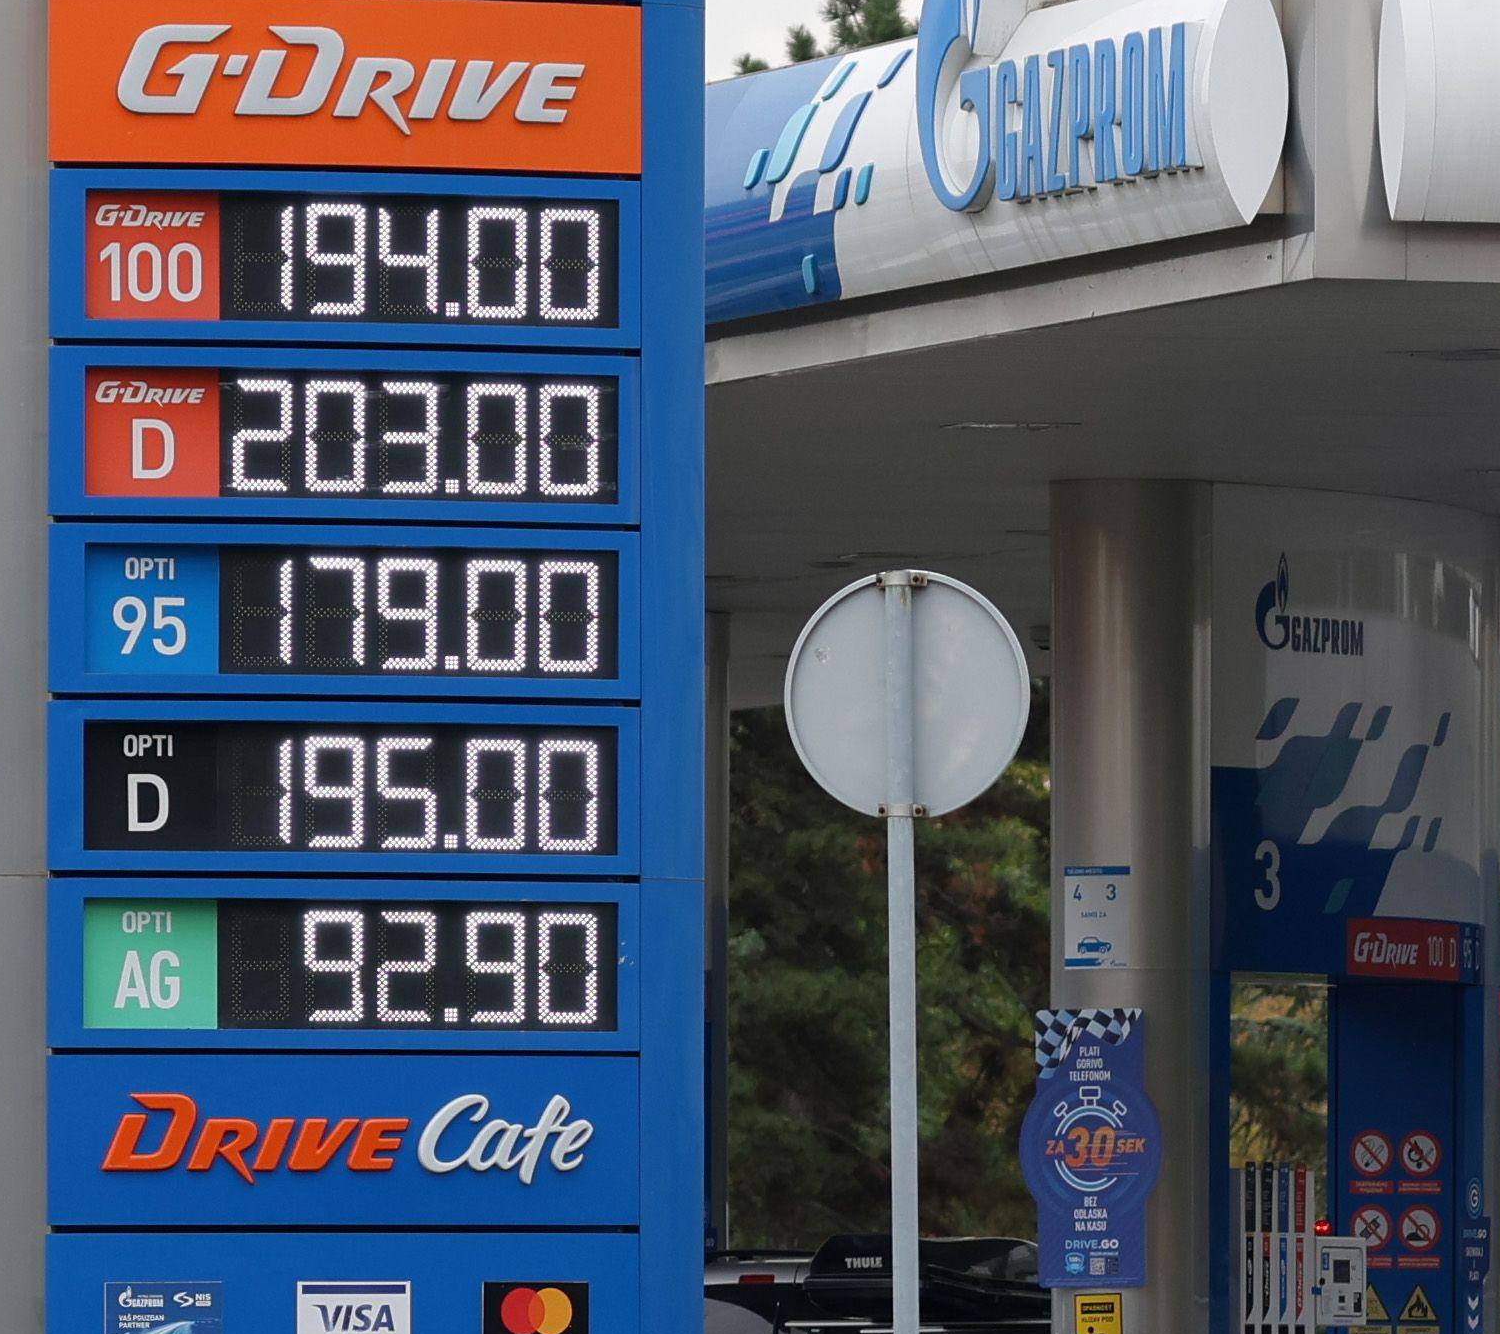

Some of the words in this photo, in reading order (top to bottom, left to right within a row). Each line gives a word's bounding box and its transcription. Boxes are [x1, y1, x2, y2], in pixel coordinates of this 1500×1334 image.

[997, 22, 1186, 201] GAZPROM
[99, 241, 202, 302] 100
[279, 203, 600, 321] 194.00
[132, 419, 176, 479] D
[231, 379, 600, 495] 203.00
[124, 557, 175, 580] OPTI
[112, 597, 187, 656] 95
[278, 557, 600, 672] 179.00
[1290, 615, 1363, 657] GAZPROM
[122, 734, 174, 757] OPTI
[127, 774, 169, 832] D
[277, 737, 599, 850] 195.00
[1254, 839, 1280, 910] 3
[1073, 884, 1082, 901] 4
[1106, 884, 1116, 901] 3
[121, 911, 173, 933] OPTI
[304, 909, 599, 1023] 92.90
[1427, 936, 1444, 967] 100
[114, 950, 181, 1009] AG
[1076, 1058, 1103, 1069] GORIVO
[1079, 1046, 1100, 1056] PLATI
[1069, 1071, 1111, 1081] TELEFONOM
[100, 1092, 409, 1186] DRIVE
[417, 1093, 595, 1186] Cafe
[1045, 1140, 1066, 1155] ZA
[1065, 1126, 1116, 1168] 30
[1115, 1138, 1146, 1154] SEK
[1074, 1208, 1108, 1219] ODLASKA
[1084, 1196, 1097, 1207] BEZ
[1075, 1221, 1085, 1231] NA
[1086, 1221, 1107, 1231] KASU
[1065, 1239, 1119, 1249] DRIVE.GO
[845, 1256, 883, 1269] THULE
[195, 1293, 211, 1301] NIS
[118, 1313, 132, 1321] VAŠ
[312, 1304, 395, 1332] VISA
